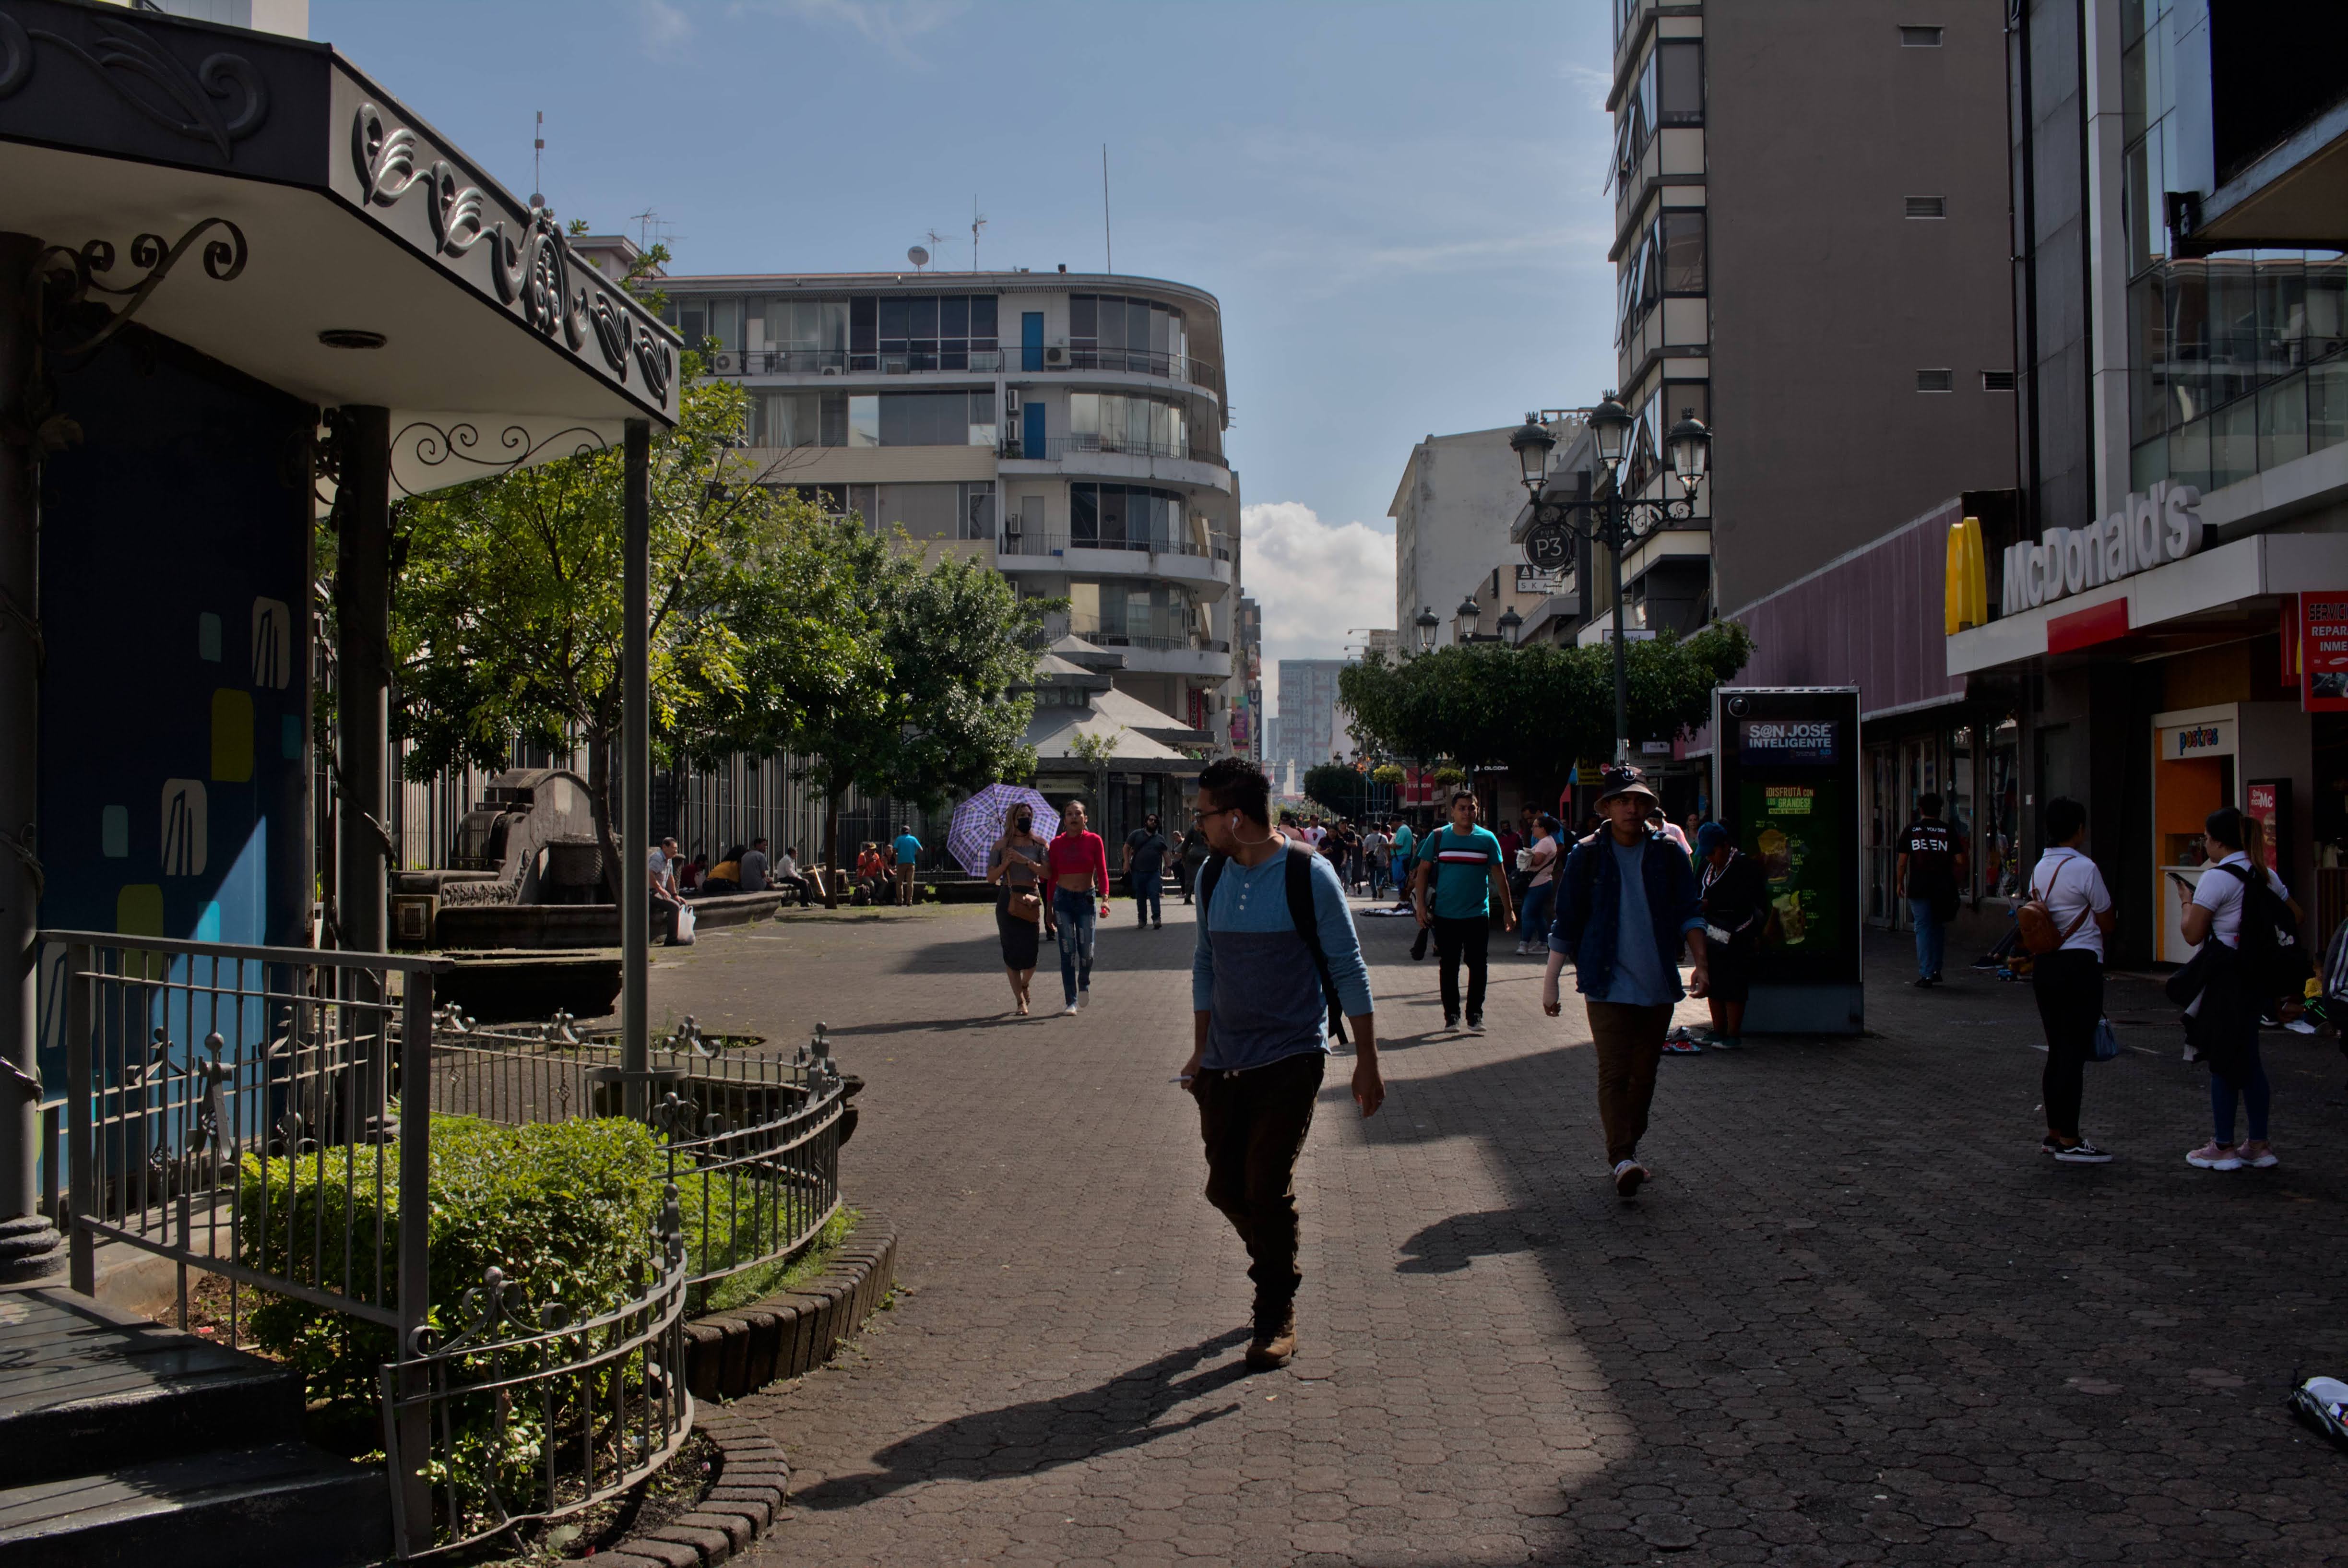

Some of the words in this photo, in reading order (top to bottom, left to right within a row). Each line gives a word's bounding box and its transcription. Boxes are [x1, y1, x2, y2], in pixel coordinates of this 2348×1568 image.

[1535, 537, 1562, 558] P3
[2002, 479, 2203, 618] McDonald's
[2308, 603, 2348, 621] SERVICI
[2311, 626, 2348, 636] REPAR
[1788, 723, 1831, 737] JOSÉ
[1749, 738, 1831, 748] INTELIGENTE
[2180, 726, 2218, 755] postres
[1803, 789, 1814, 797] CON
[2259, 792, 2273, 808] Mc
[1778, 798, 1811, 808] GRANDES!
